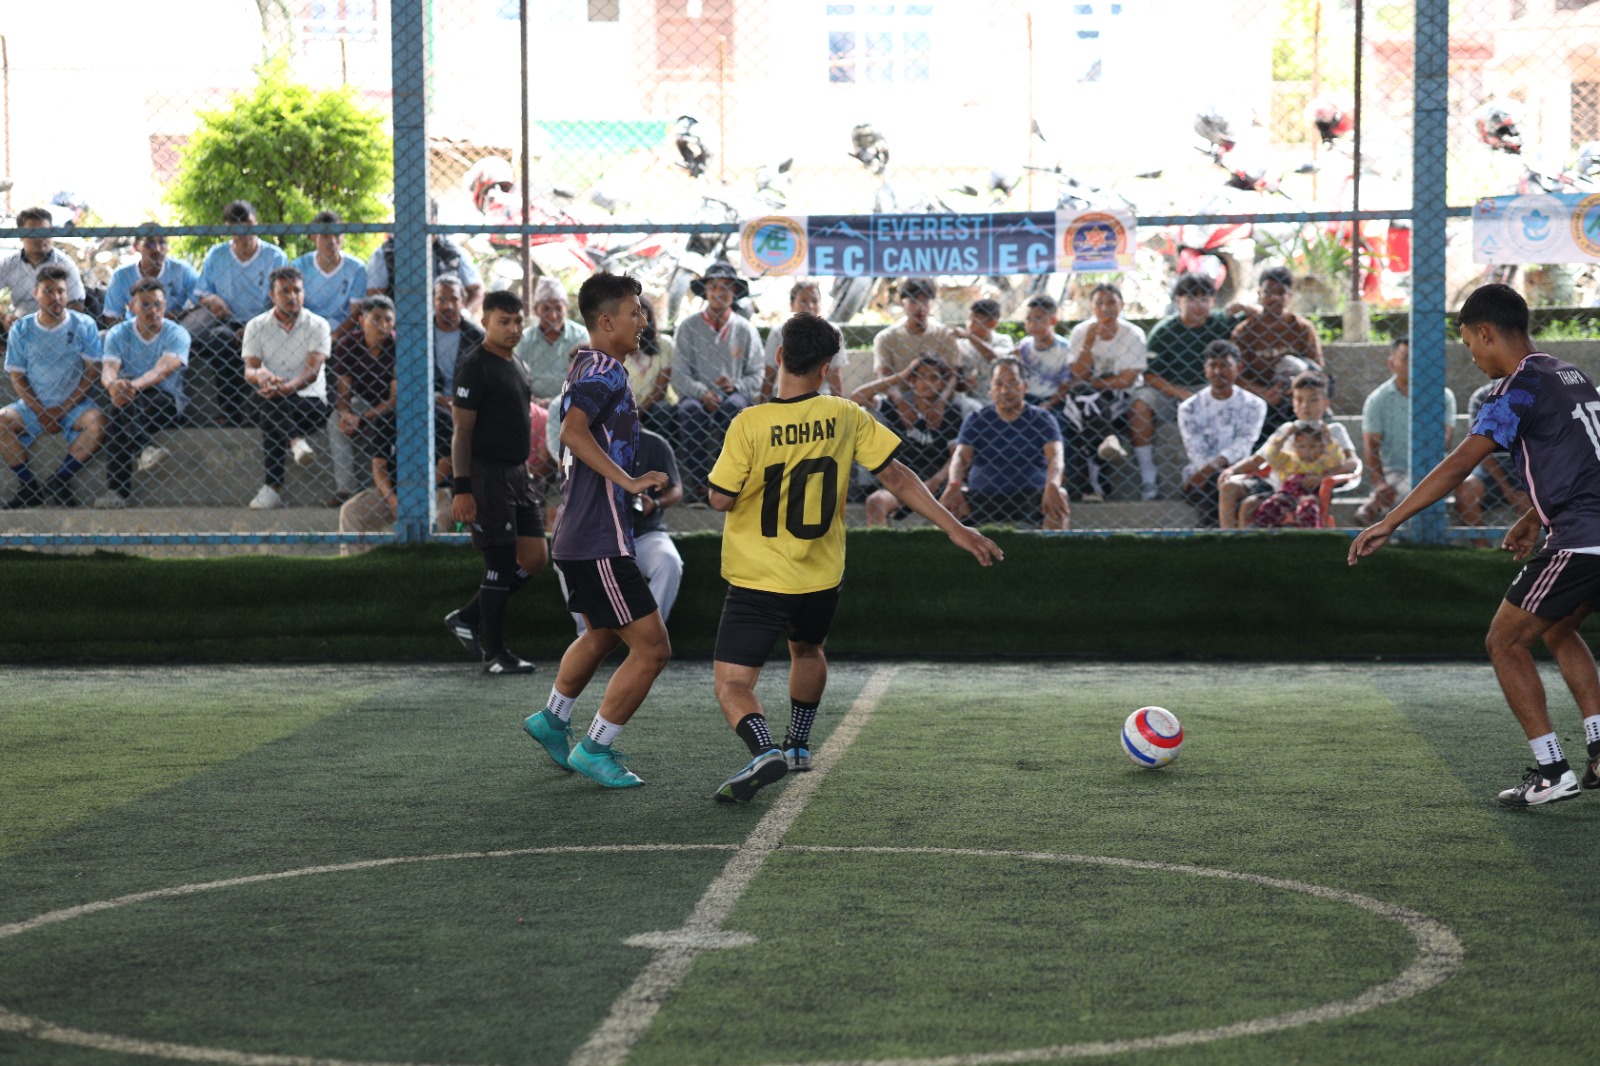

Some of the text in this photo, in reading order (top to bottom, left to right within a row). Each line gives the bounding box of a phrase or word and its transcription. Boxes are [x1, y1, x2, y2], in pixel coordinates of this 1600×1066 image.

[877, 216, 985, 241] EVEREST
[882, 246, 979, 272] CANVAS
[1555, 369, 1587, 385] THAPA
[770, 417, 837, 447] ROHAN
[760, 455, 838, 540] 10
